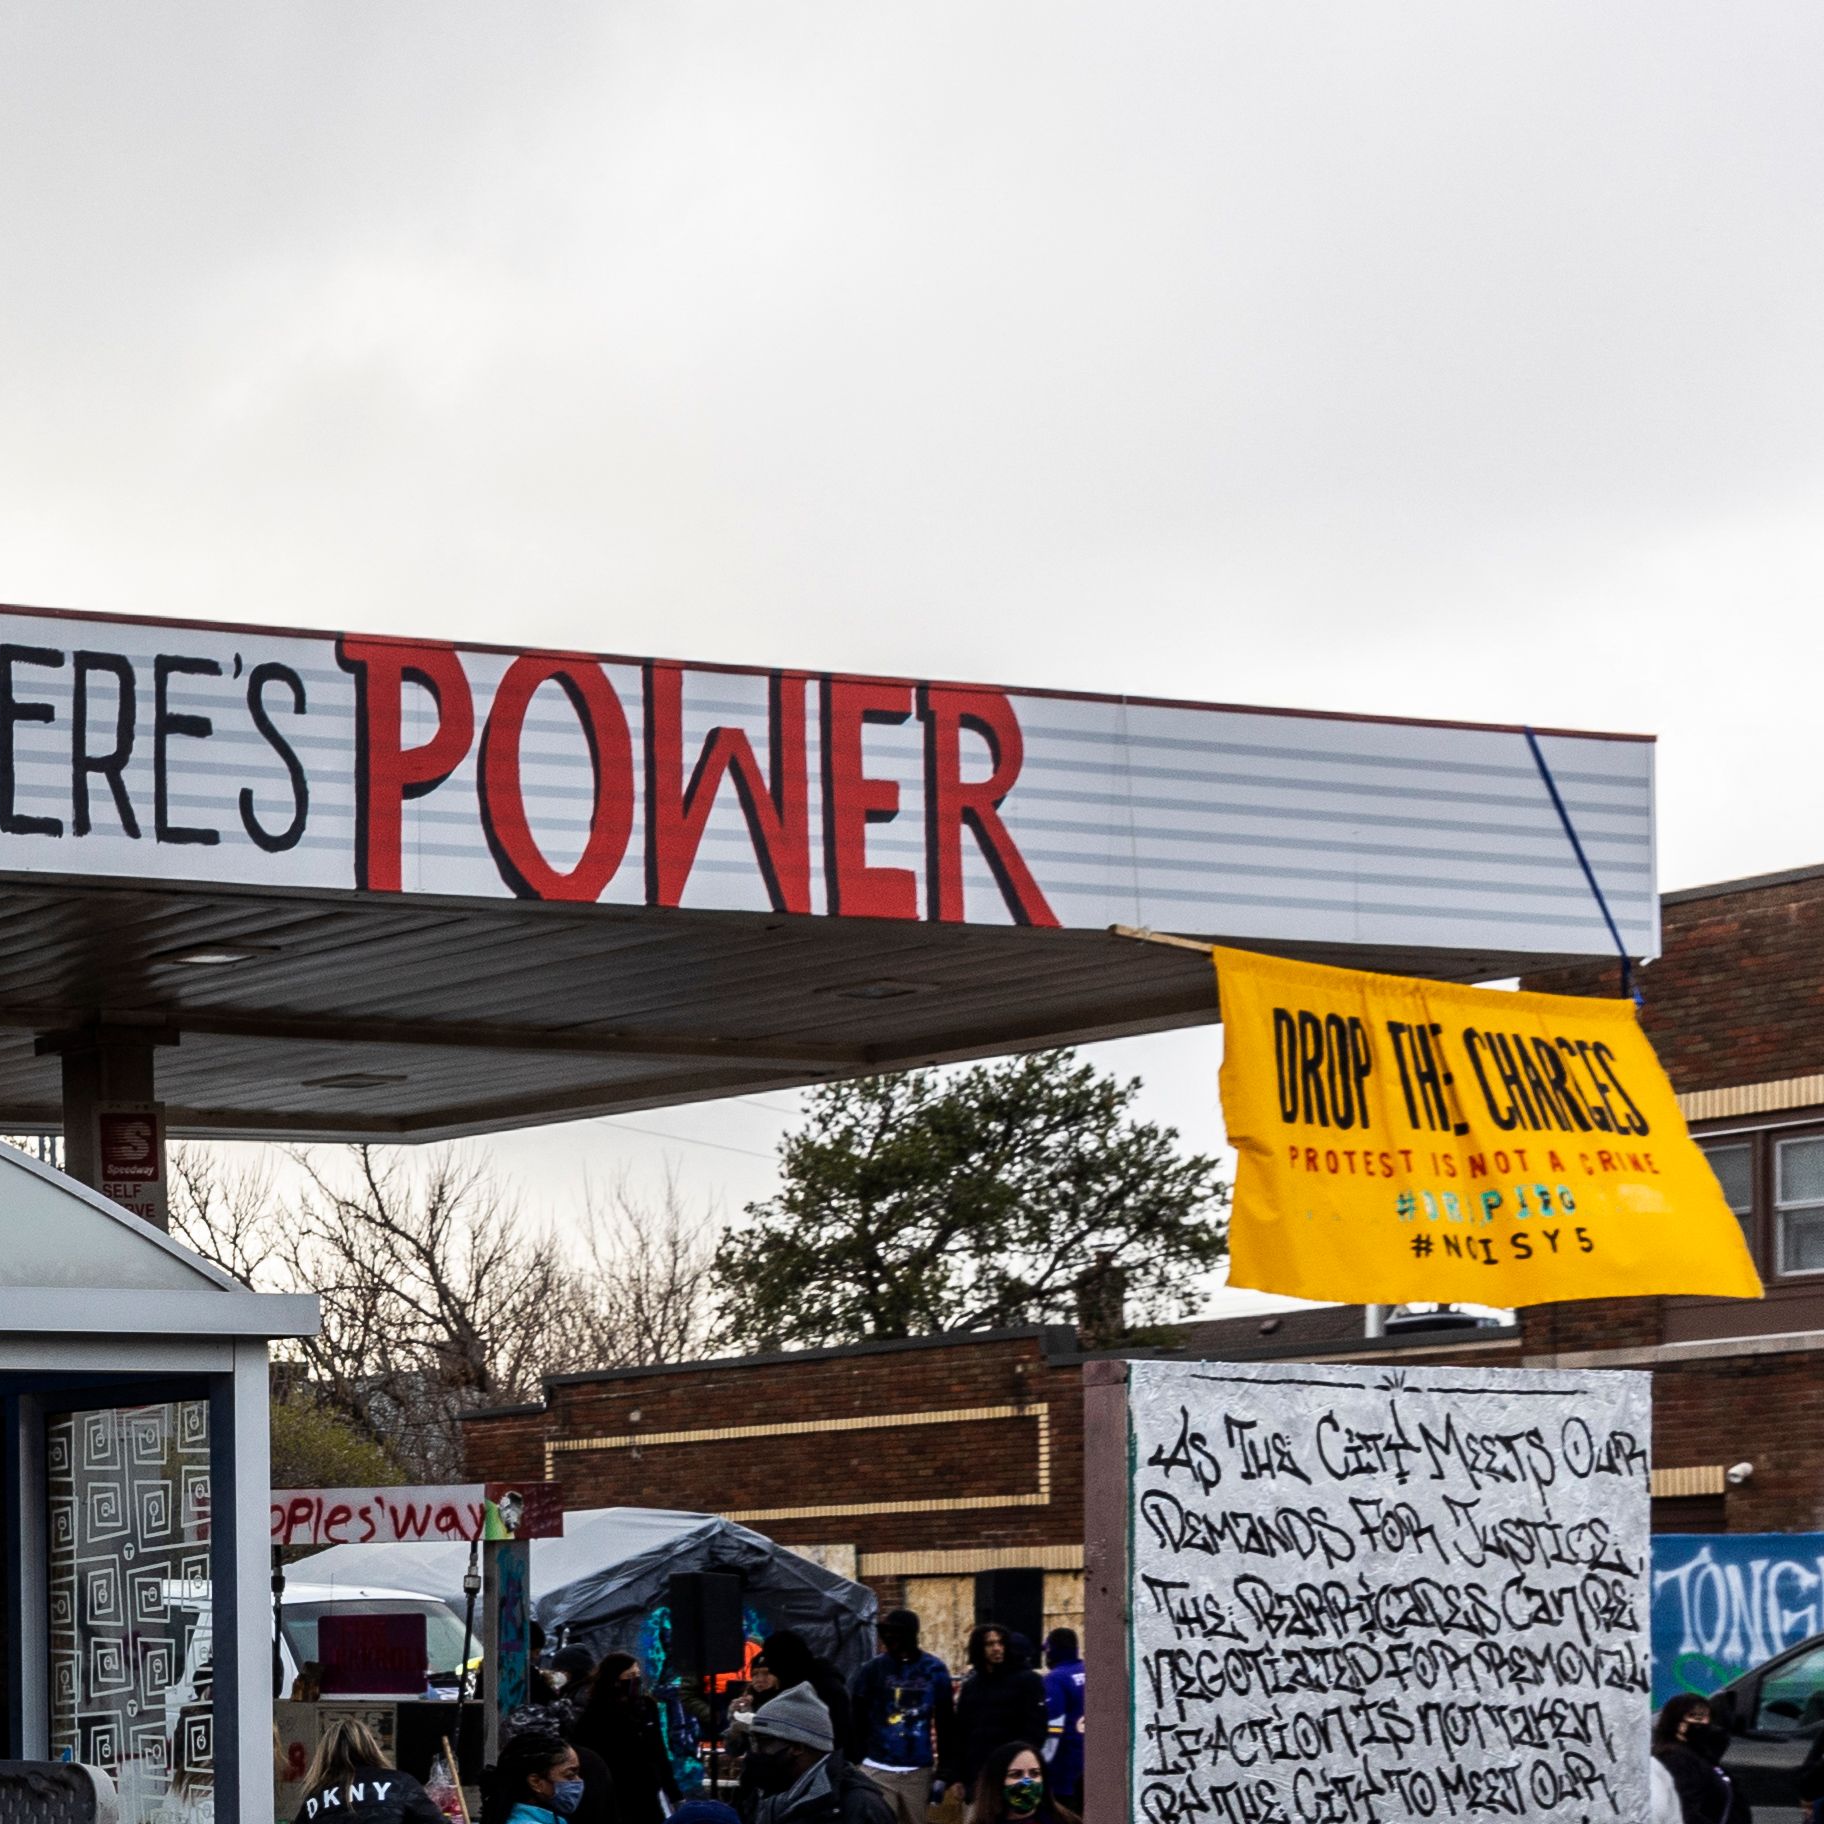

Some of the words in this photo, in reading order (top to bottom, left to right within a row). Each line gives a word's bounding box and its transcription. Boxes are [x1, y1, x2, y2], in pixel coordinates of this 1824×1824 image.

[336, 635, 1062, 929] POWER
[1273, 1008, 1371, 1130] DROP
[1387, 1020, 1471, 1136] THE
[1464, 1026, 1649, 1136] CHARGES
[104, 1184, 141, 1198] SELF
[107, 1164, 154, 1176] Speedway
[1289, 1145, 1413, 1178] PROTEST
[1433, 1153, 1458, 1177] IS
[1471, 1150, 1530, 1179] NOT
[1550, 1151, 1565, 1172] A
[1580, 1152, 1660, 1176] CRIME
[1224, 1414, 1311, 1484] THE
[1316, 1397, 1420, 1485] CITY
[1418, 1413, 1556, 1504] MEETS
[1561, 1417, 1650, 1493] OUR
[389, 1503, 487, 1541] way
[1142, 1489, 1354, 1569] DEMANDS
[1349, 1497, 1449, 1564] FOR
[1142, 1573, 1247, 1641] THE
[1234, 1573, 1500, 1641] BARRICADES
[1655, 1546, 1824, 1663] TONG
[306, 1781, 393, 1820] DKNY
